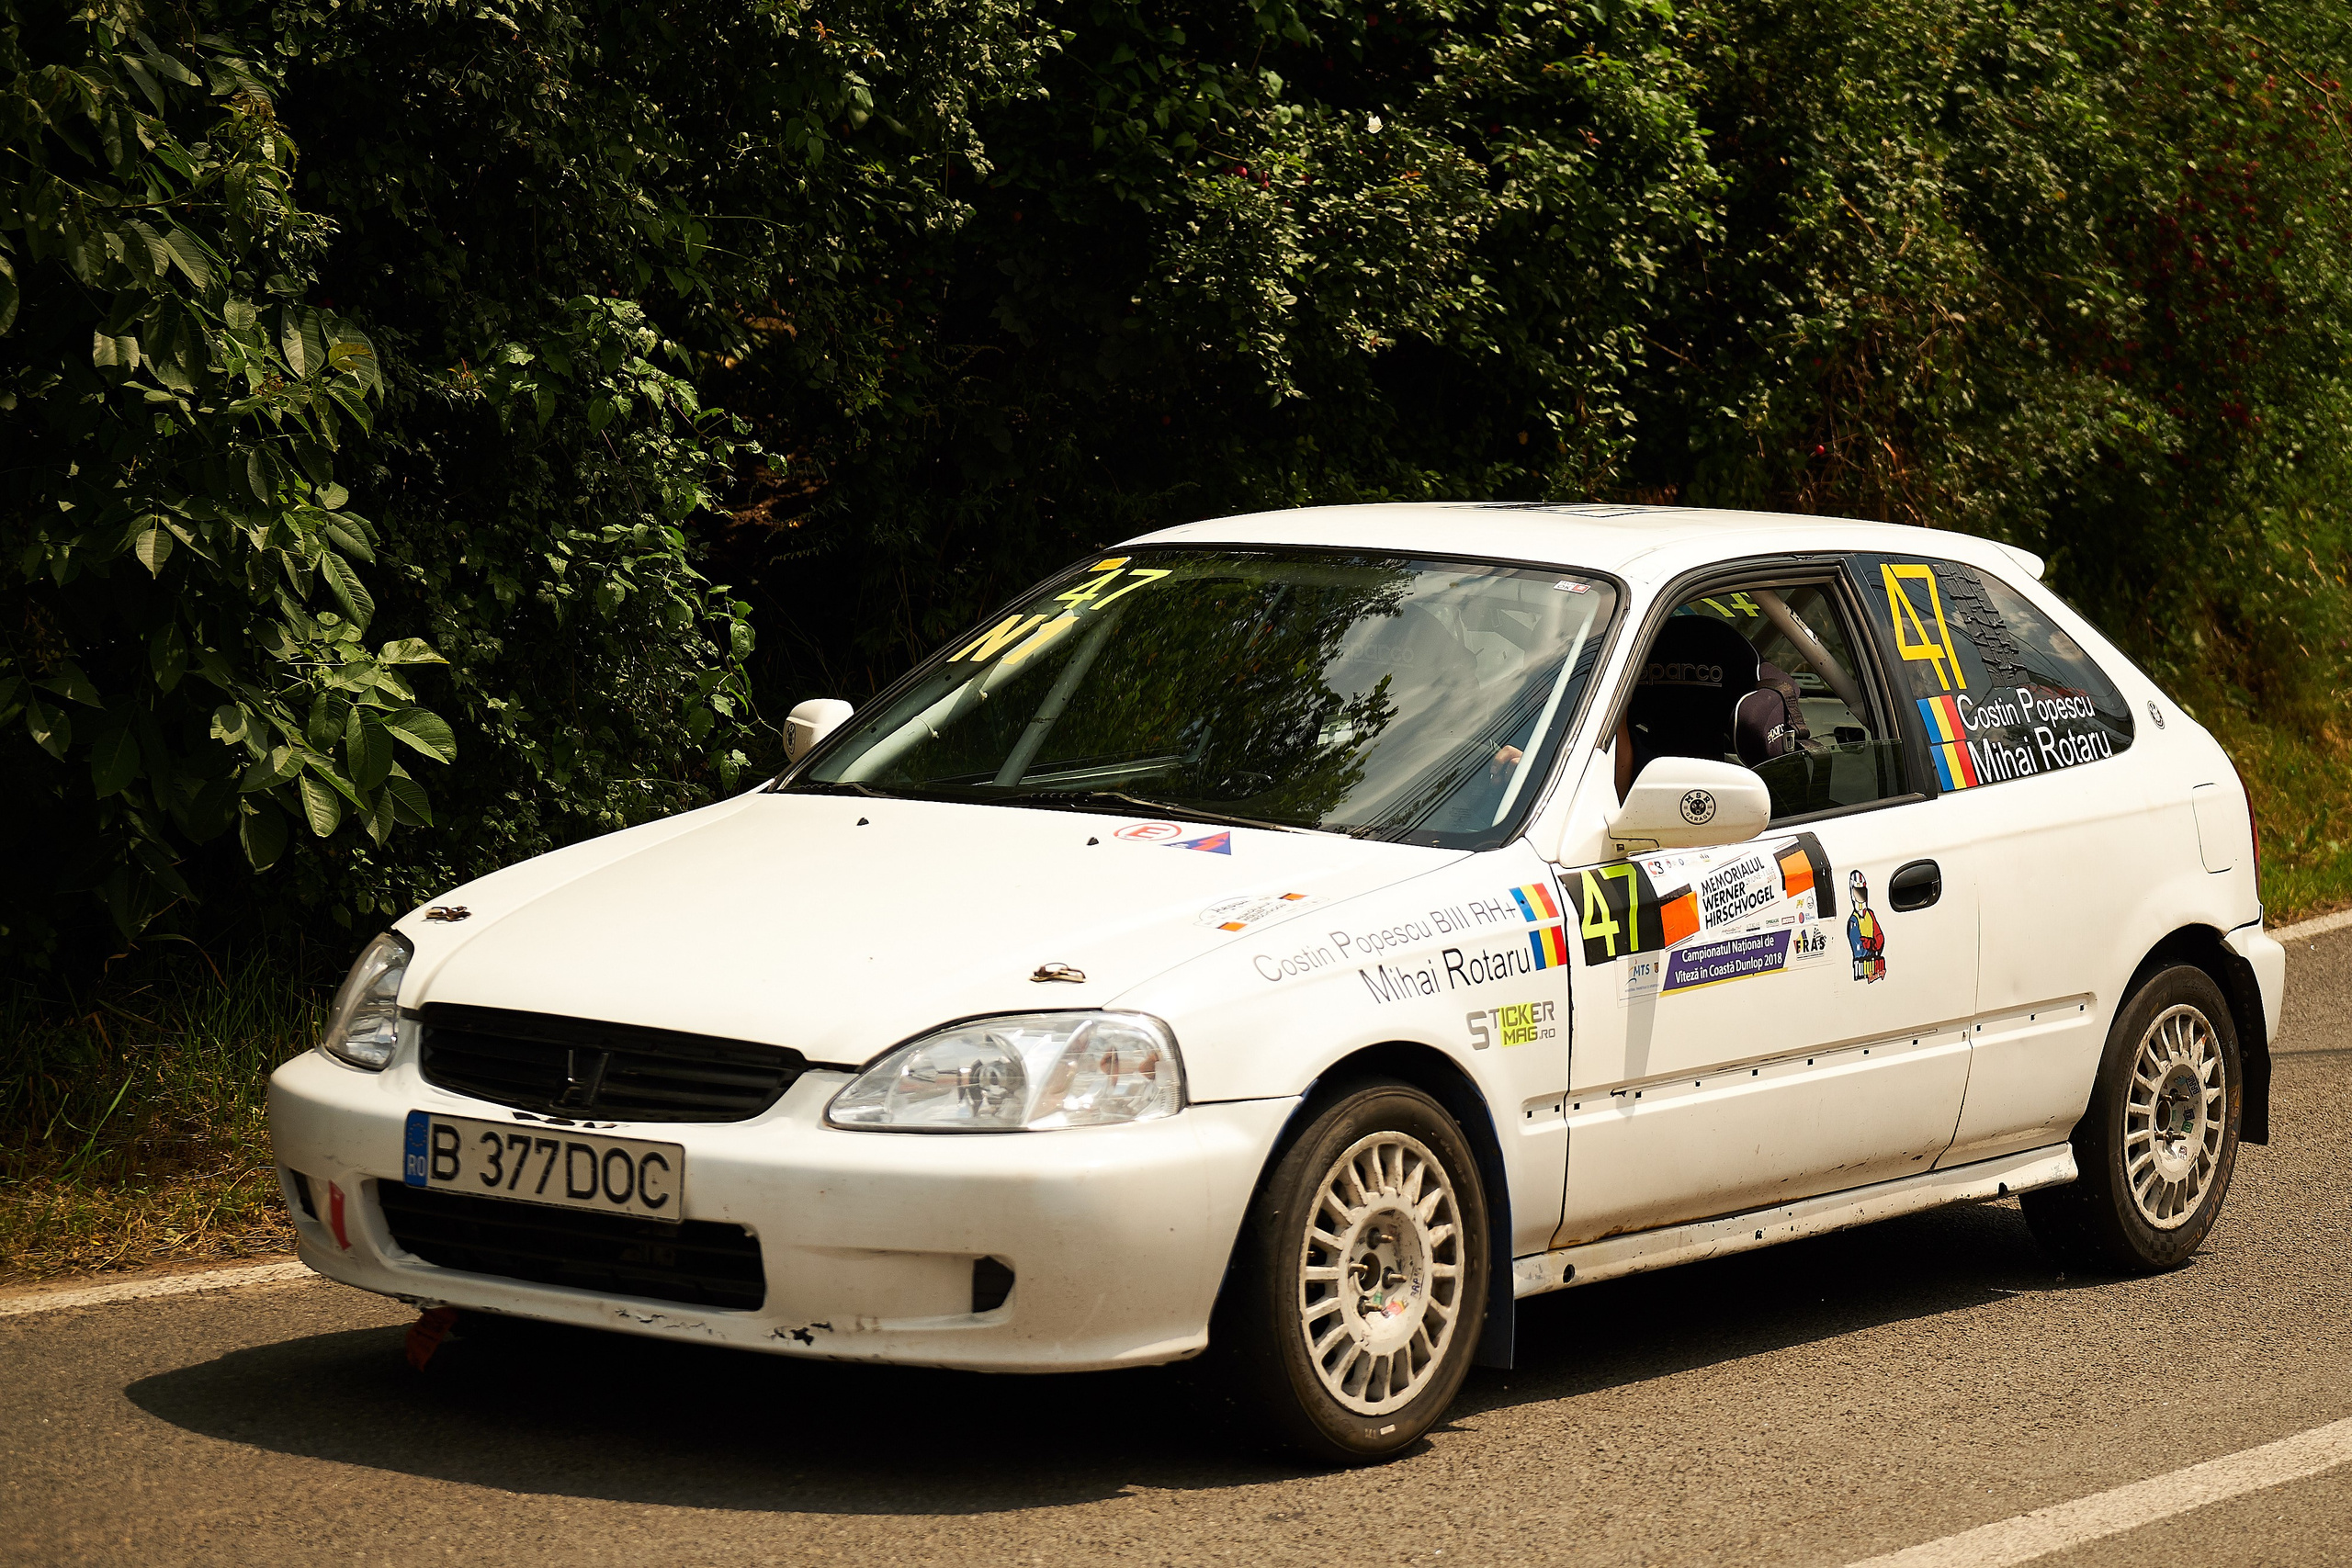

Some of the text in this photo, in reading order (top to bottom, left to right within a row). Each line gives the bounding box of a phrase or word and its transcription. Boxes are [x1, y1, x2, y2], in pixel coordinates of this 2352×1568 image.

[1053, 568, 1173, 610] 47
[946, 614, 1080, 665] N1
[1880, 563, 1968, 691] 47
[1956, 688, 2096, 731] Costin Popescu
[1967, 725, 2112, 784] Mihai Rotaru
[1701, 856, 1765, 897] MEMORIALUL
[1702, 881, 1746, 912] WERNER
[1580, 863, 1639, 957] 47
[1705, 885, 1775, 930] HIRSCHVOGEL
[1253, 944, 1337, 982] Costin
[1329, 919, 1433, 959] Popescu
[1468, 897, 1517, 925] RH+
[1681, 939, 1731, 964] Campionatul
[1764, 934, 1775, 947] de
[1796, 936, 1826, 954] FRAS
[1359, 946, 1531, 1004] Mihai Rotaru
[1633, 964, 1650, 977] MTS
[1675, 952, 1782, 984] Viteză în Coastă Dunlop 2018
[1466, 1000, 1555, 1051] STICKER
[407, 1153, 426, 1178] RO
[431, 1122, 461, 1181] B
